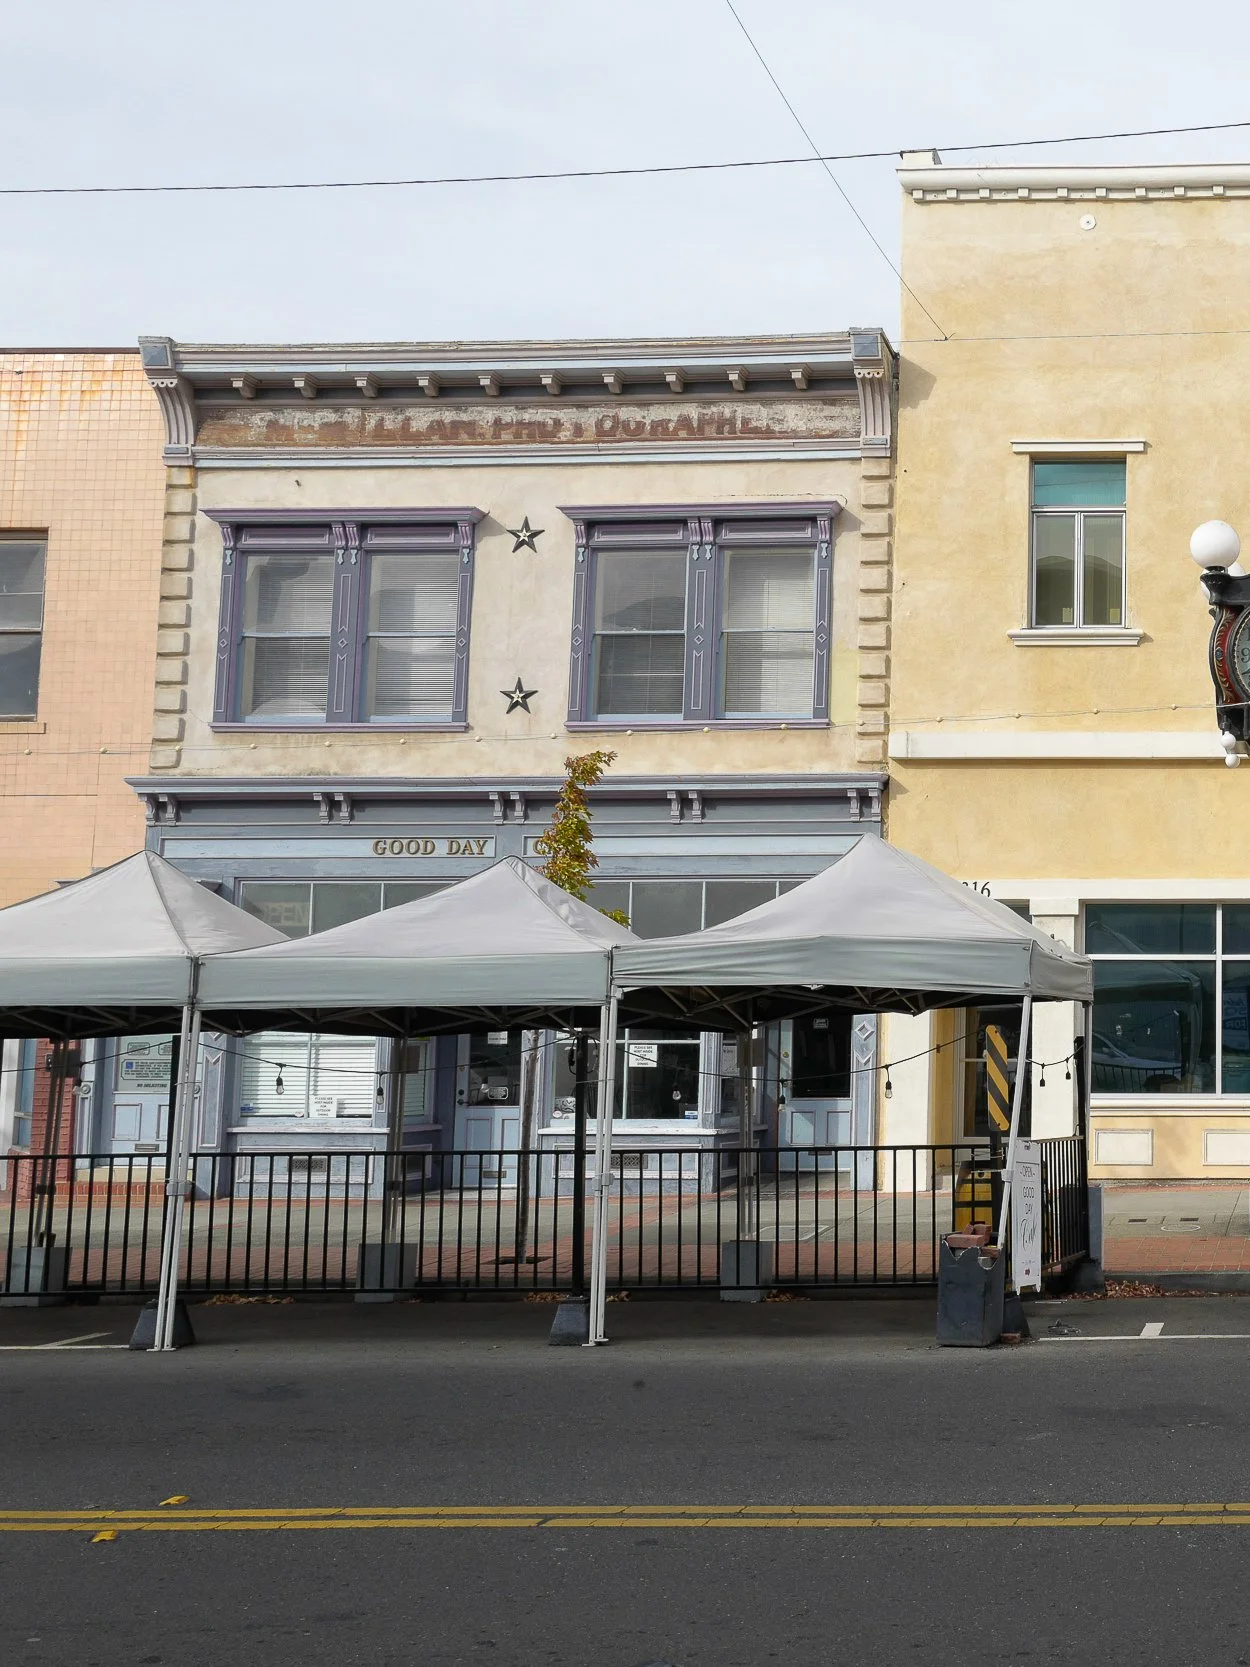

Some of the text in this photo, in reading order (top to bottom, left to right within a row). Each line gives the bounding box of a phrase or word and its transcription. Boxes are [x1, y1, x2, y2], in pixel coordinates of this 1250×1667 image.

[372, 839, 489, 855] GOOD DAY
[262, 902, 309, 926] PEN
[1022, 1186, 1035, 1198] GOOD
[1024, 1203, 1033, 1215] DAY
